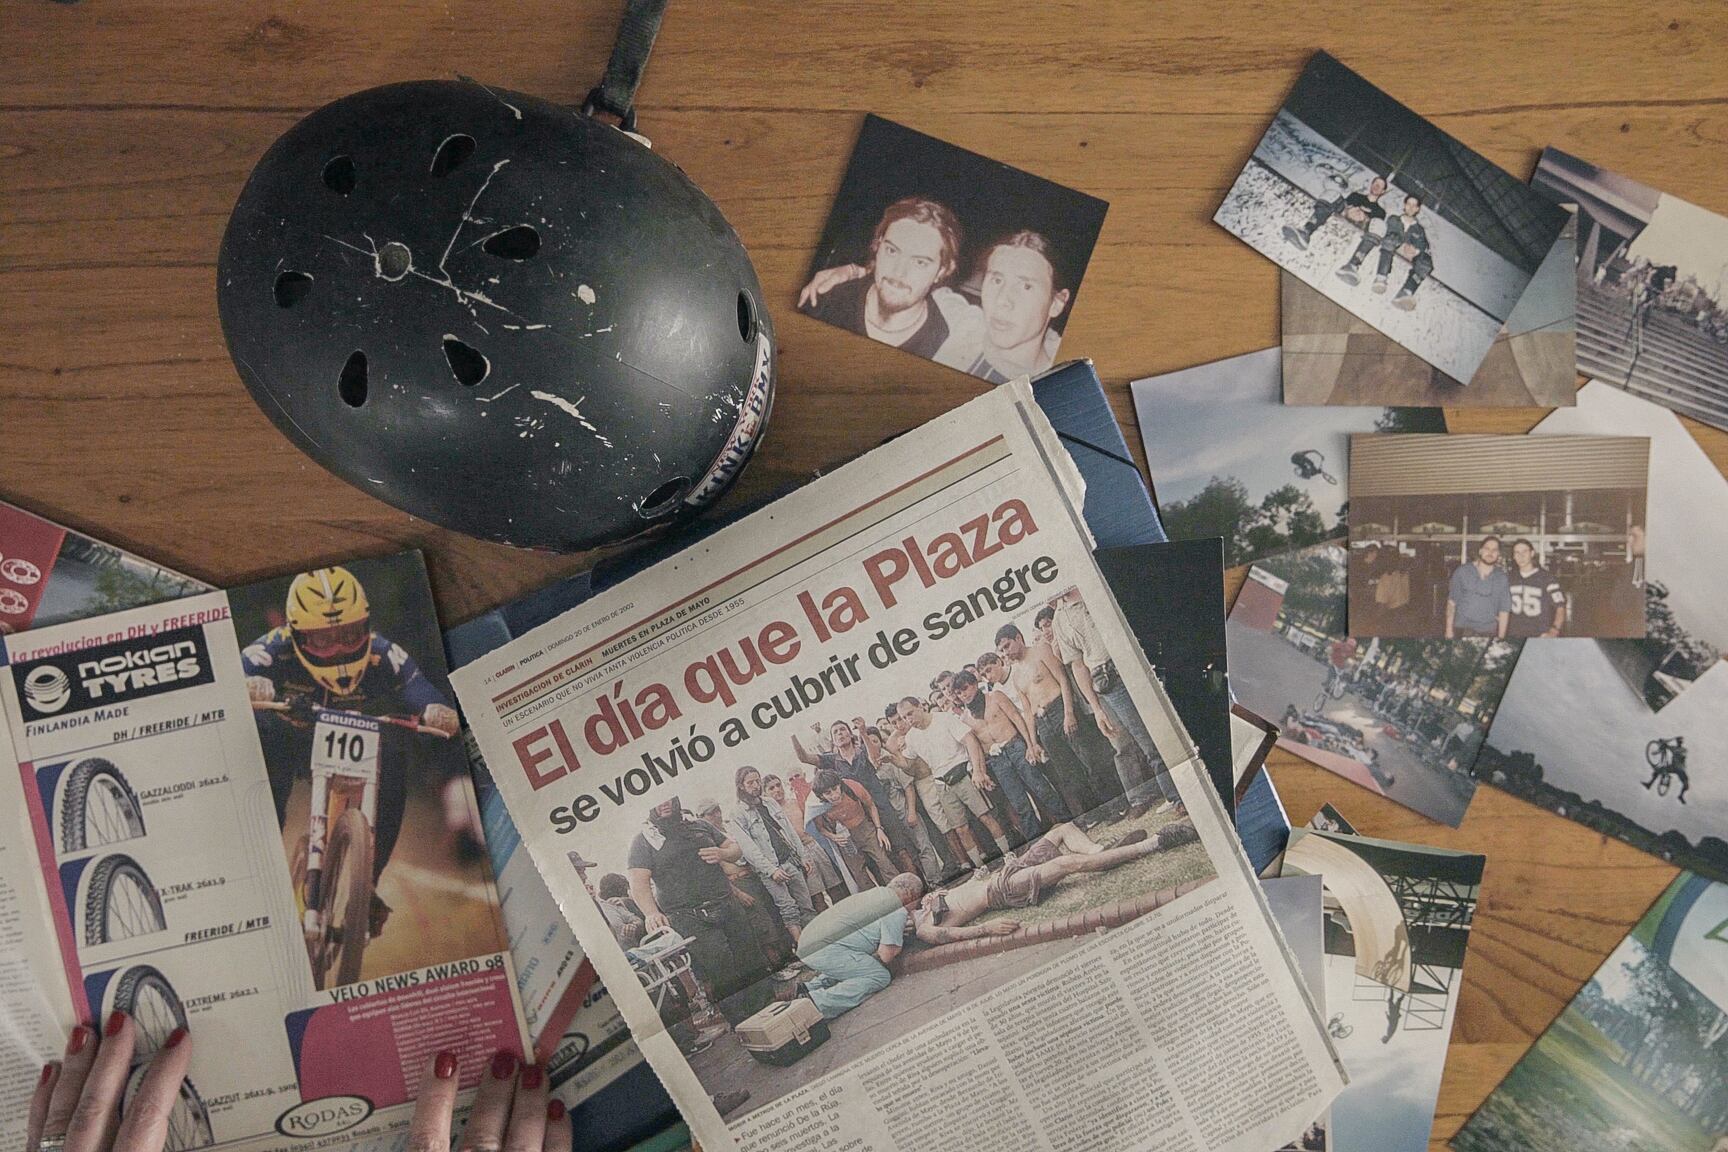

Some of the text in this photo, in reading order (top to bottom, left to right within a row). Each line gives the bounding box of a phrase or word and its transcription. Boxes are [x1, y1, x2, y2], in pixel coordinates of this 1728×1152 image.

[750, 348, 771, 417] BMX
[696, 435, 750, 502] KINK
[12, 606, 230, 663] La revolucion en DH y FREERIDE
[512, 719, 581, 791] El
[584, 680, 682, 755] día
[684, 621, 801, 708] que
[796, 587, 870, 643] la
[862, 499, 1039, 610] Plaza
[547, 632, 574, 652] DOMINGO
[582, 624, 591, 633] DE
[591, 614, 610, 629] ENERO
[610, 609, 619, 619] DE
[601, 597, 710, 658] MUERTES EN PLAZA DE MAYO
[77, 640, 197, 678] nokian
[82, 657, 201, 699] TYRES
[502, 597, 745, 728] UN ESCENARIO QUE NO VIVIA TANTA VIOLENCIA POLITICA DESDE 1955
[496, 657, 593, 712] INVESTIGACION DE CLARIN
[550, 795, 600, 834] se
[598, 724, 715, 806] volvió
[719, 718, 750, 747] a
[751, 653, 861, 729] cubrir
[868, 628, 920, 669] de
[923, 556, 1058, 640] sangre
[113, 731, 128, 742] DH
[139, 716, 189, 735] FREERIDE
[201, 709, 225, 722] MTB
[325, 730, 364, 763] 110
[184, 923, 234, 942] FREERIDE
[246, 916, 270, 929] MTB
[185, 991, 226, 1009] EXTREME
[330, 983, 369, 1003] VELO
[375, 971, 420, 994] NEWS
[425, 960, 480, 983] AWARD
[485, 955, 505, 971] 98
[289, 1102, 363, 1131] RODAS
[740, 1128, 758, 1141] Fue
[758, 1117, 781, 1132] hace
[782, 1110, 795, 1120] un
[818, 1091, 828, 1102] el
[829, 1086, 844, 1097] día
[758, 1120, 796, 1145] renunció
[795, 1114, 810, 1125] De
[809, 1110, 820, 1118] la
[789, 1120, 827, 1142] muertos.
[827, 1112, 840, 1122] La
[829, 1124, 840, 1132] la
[820, 1137, 838, 1150] Las
